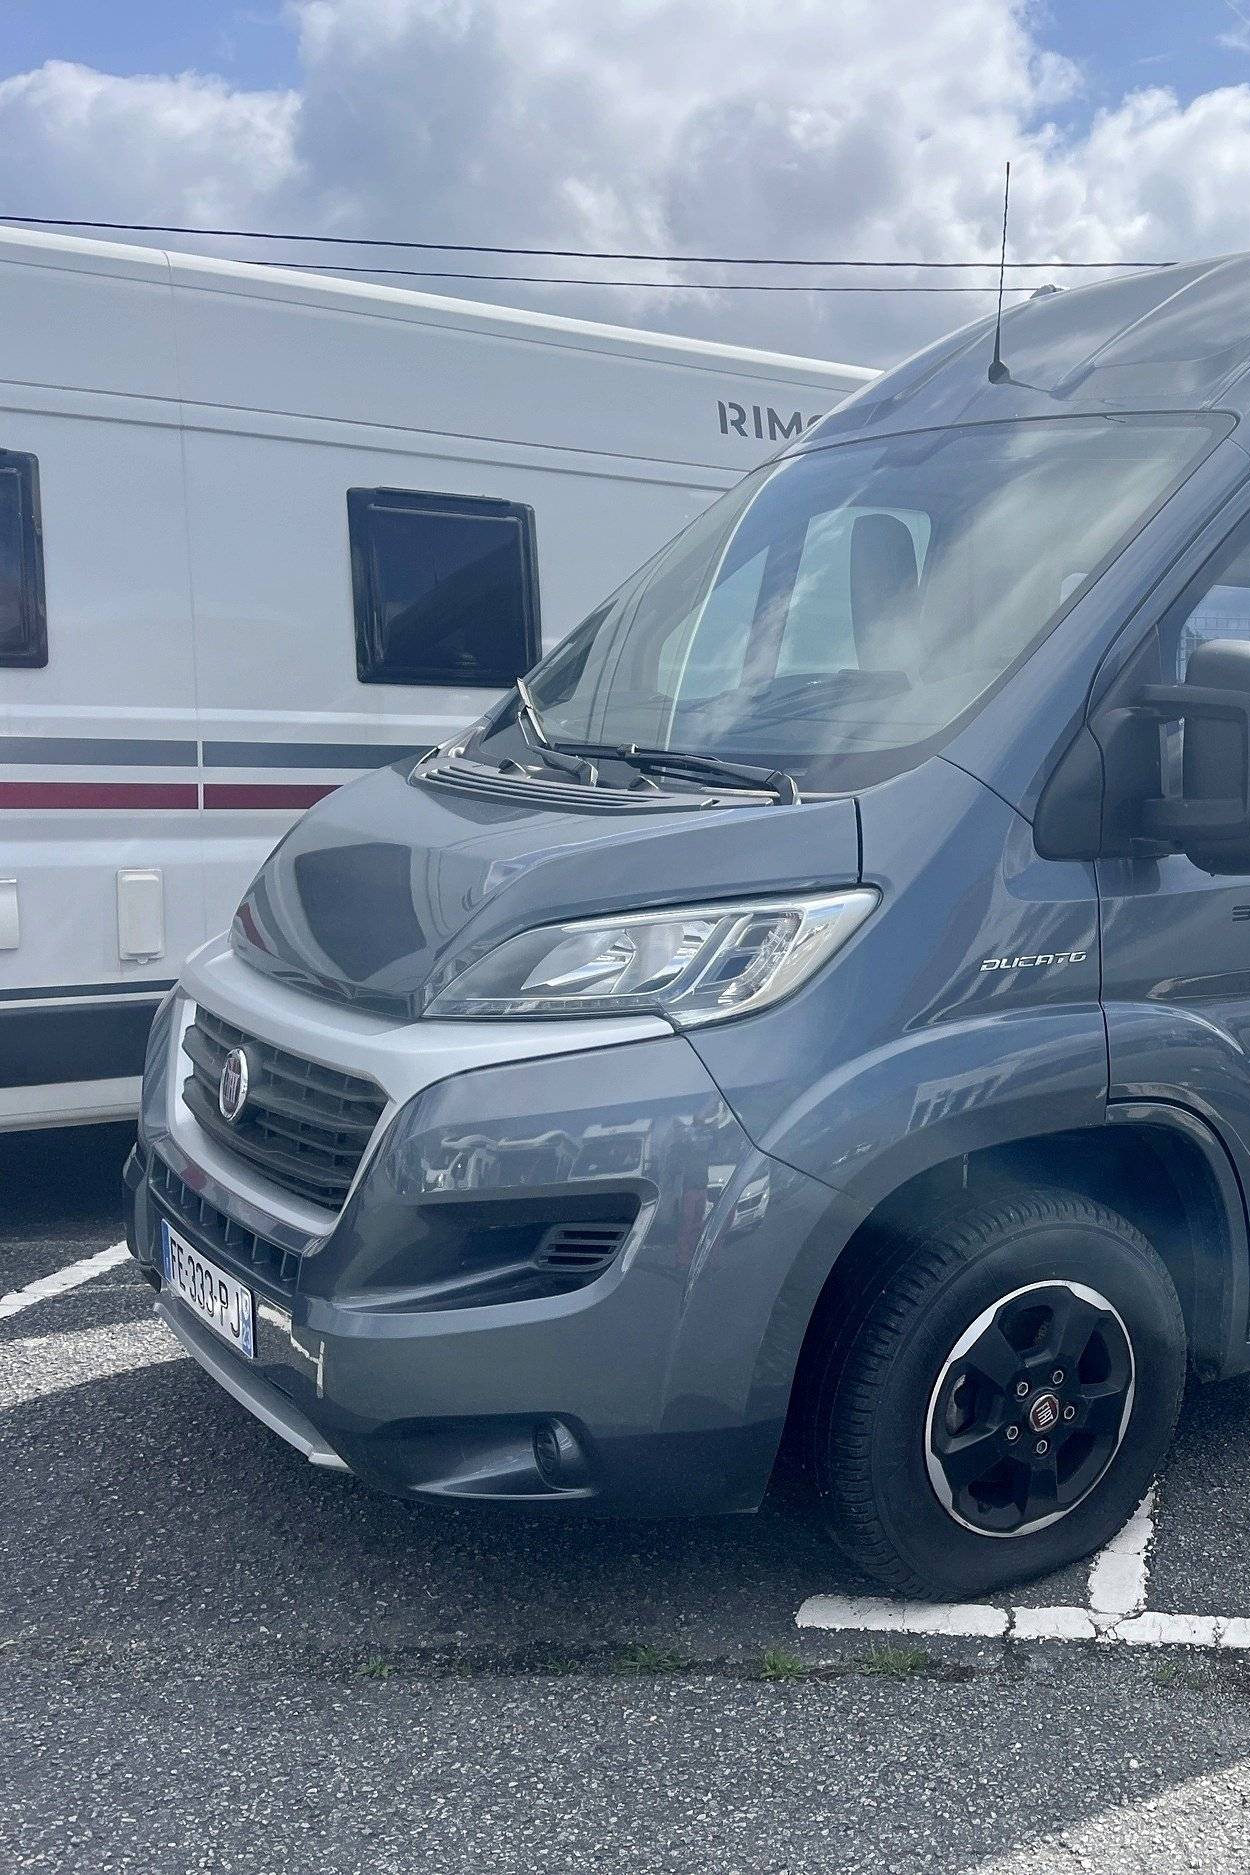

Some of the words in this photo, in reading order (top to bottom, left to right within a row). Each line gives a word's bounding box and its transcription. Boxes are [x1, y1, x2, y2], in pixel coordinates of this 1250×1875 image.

[980, 952, 1087, 971] DUCATO
[170, 1236, 240, 1339] FE-333-PJ
[1036, 1402, 1054, 1426] FIAT
